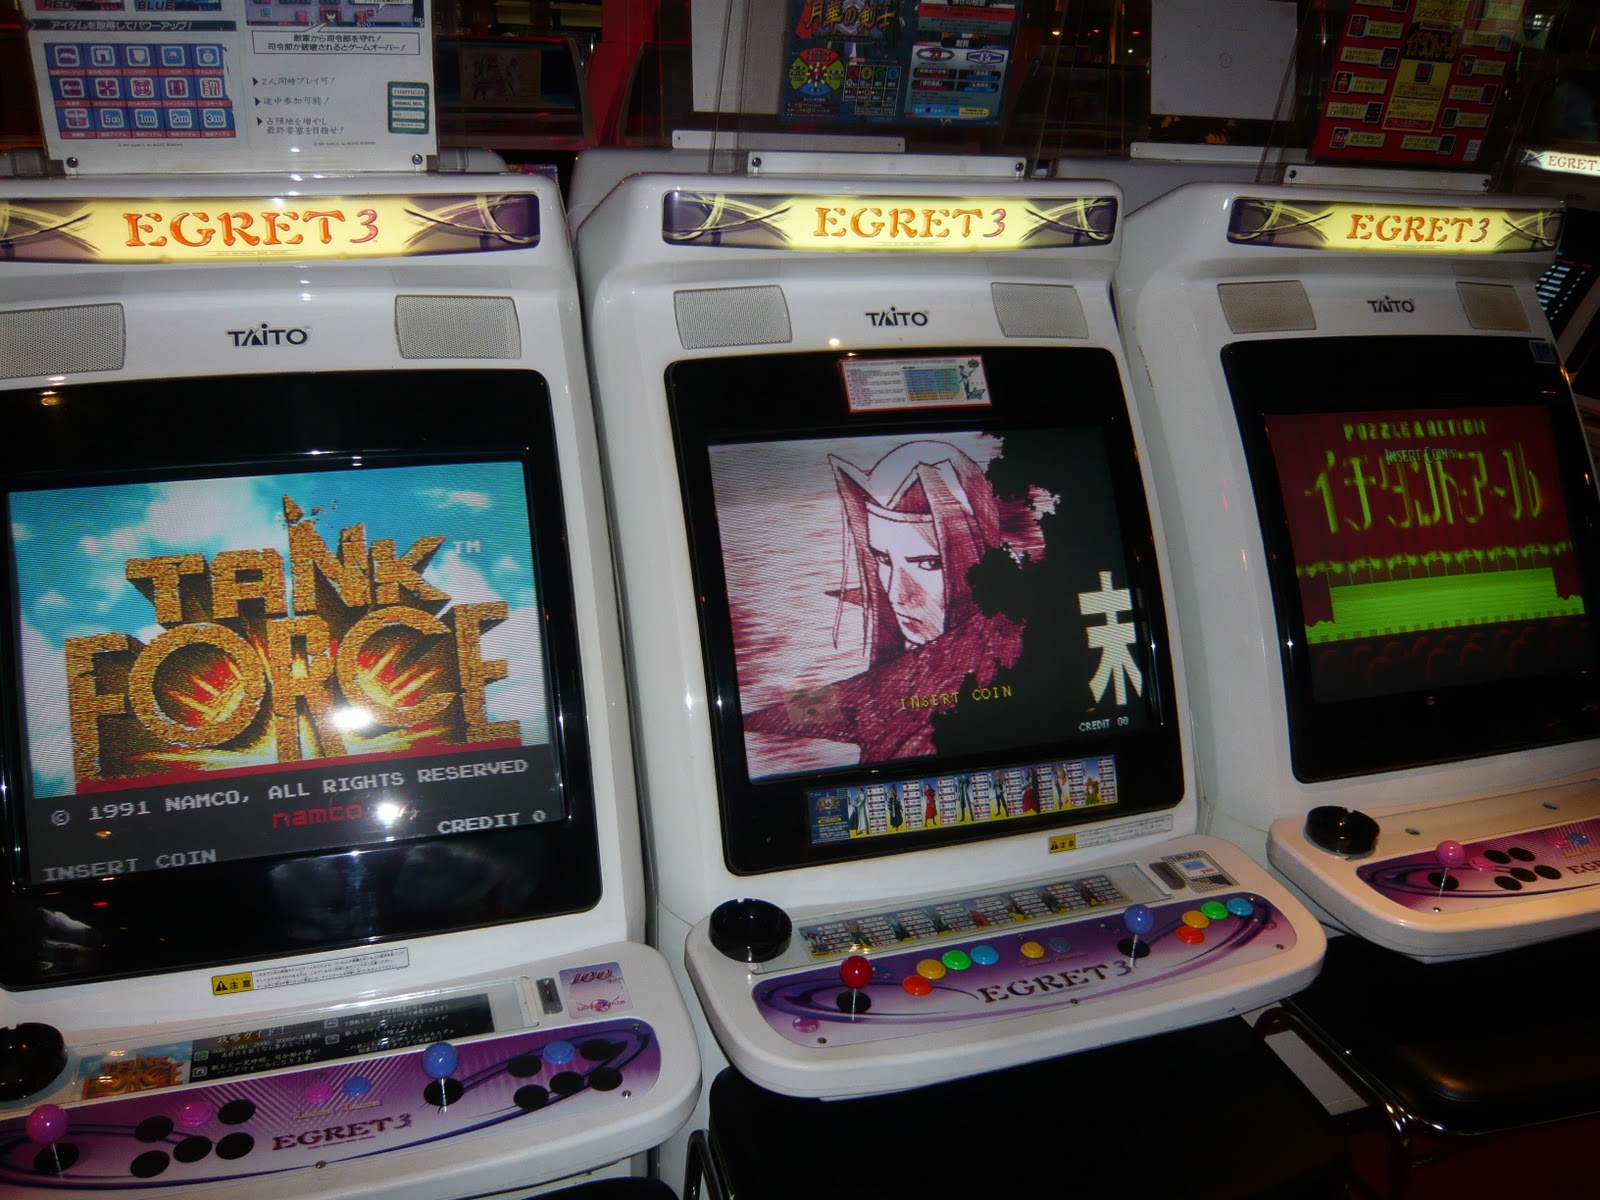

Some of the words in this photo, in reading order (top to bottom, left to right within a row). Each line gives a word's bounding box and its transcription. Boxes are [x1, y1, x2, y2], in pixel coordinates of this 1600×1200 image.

[293, 34, 381, 43] 敵軍から司令部を守れ!
[262, 96, 330, 106] 途中参加可能!
[266, 116, 328, 126] 占領地を増やし
[1548, 155, 1598, 171] EGRET
[123, 209, 347, 248] EGRET
[349, 208, 379, 245] 3
[813, 206, 983, 239] EGRET
[983, 207, 1006, 238] 3
[1346, 213, 1474, 243] EGRET
[1470, 217, 1490, 243] 3
[125, 494, 452, 623] TANK
[453, 539, 481, 554] TM
[64, 601, 521, 788] FORCE
[900, 690, 960, 711] INSERT
[971, 684, 1013, 702] COIN
[1078, 717, 1111, 732] CREDIT
[88, 800, 151, 822] 1991
[164, 789, 250, 815] NAMCO,
[268, 782, 311, 800] ALL
[322, 770, 405, 794] RIGHTS
[416, 758, 530, 784] RESERVED
[271, 803, 364, 829] namco
[437, 811, 520, 834] CREDIT
[43, 855, 139, 883] INSERT
[155, 848, 218, 870] COIN
[229, 980, 251, 990] 注意
[977, 965, 1109, 1004] EGRET
[1105, 959, 1132, 977] 3
[272, 1116, 394, 1151] EGRET
[393, 1112, 413, 1130] 3
